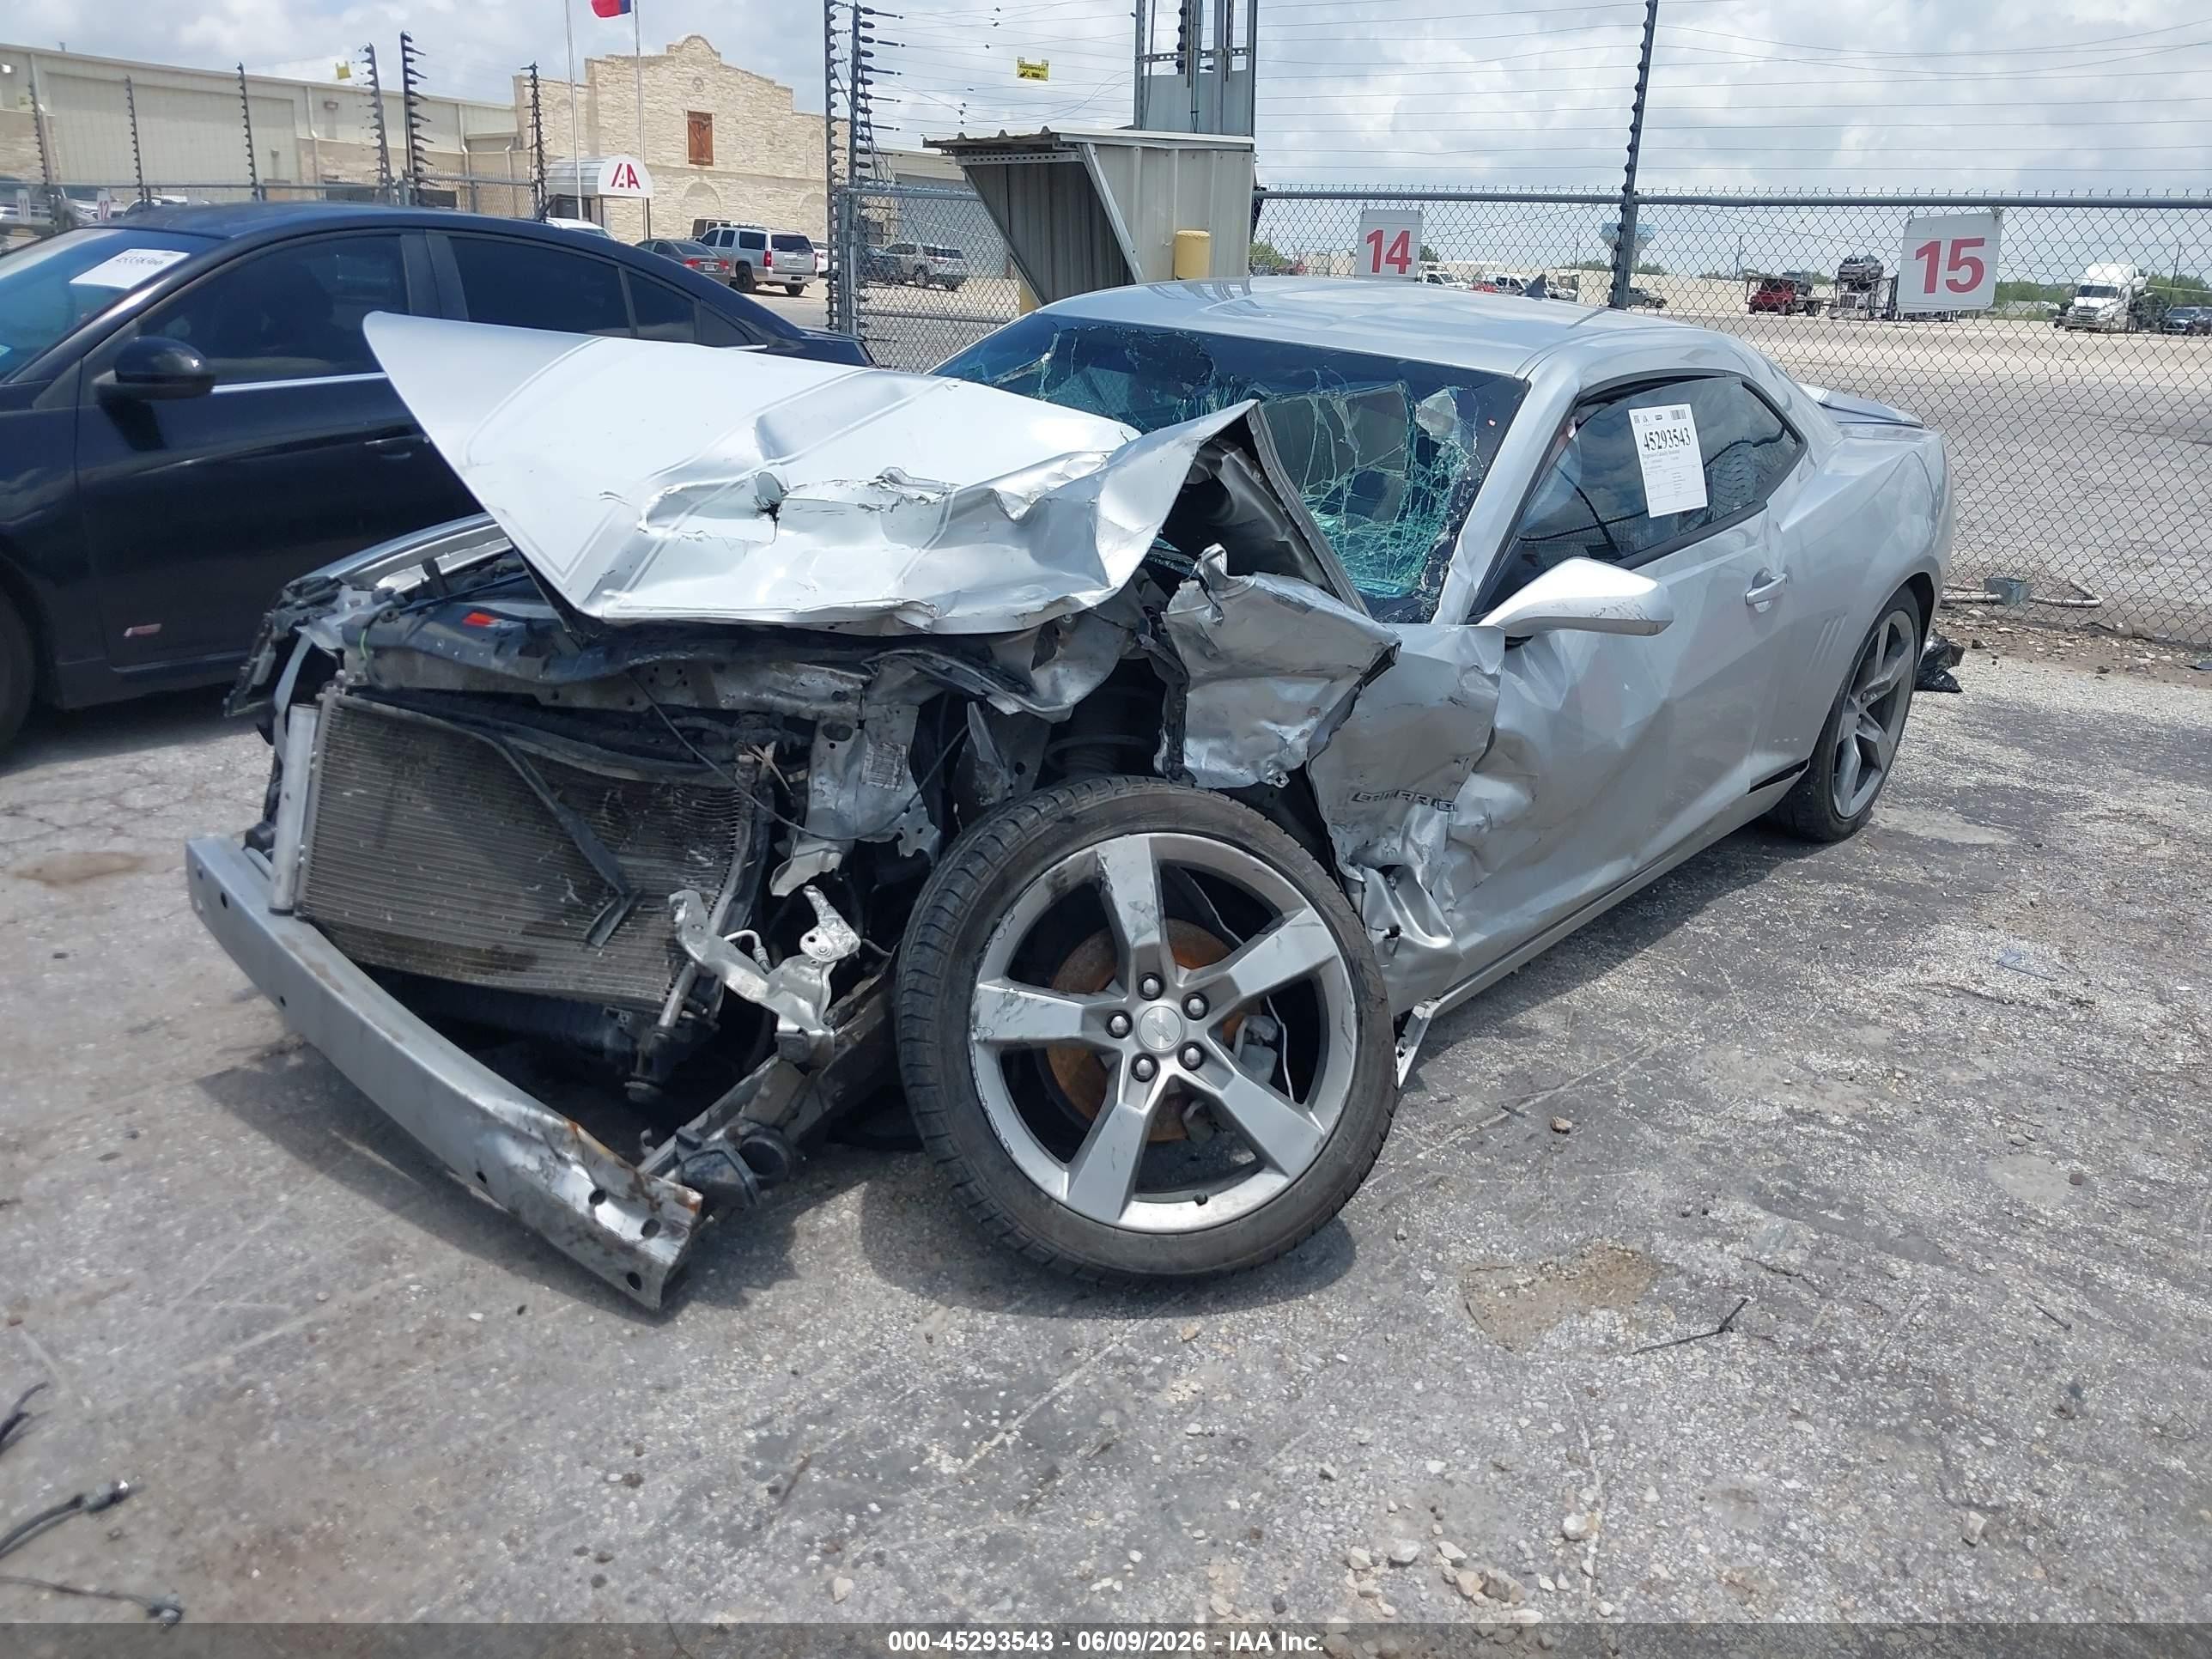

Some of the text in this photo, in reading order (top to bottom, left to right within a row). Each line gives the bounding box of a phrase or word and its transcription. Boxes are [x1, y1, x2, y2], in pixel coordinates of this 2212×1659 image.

[1366, 229, 1413, 275] 14
[1914, 237, 1986, 295] 15
[1643, 427, 1691, 452] 45293543
